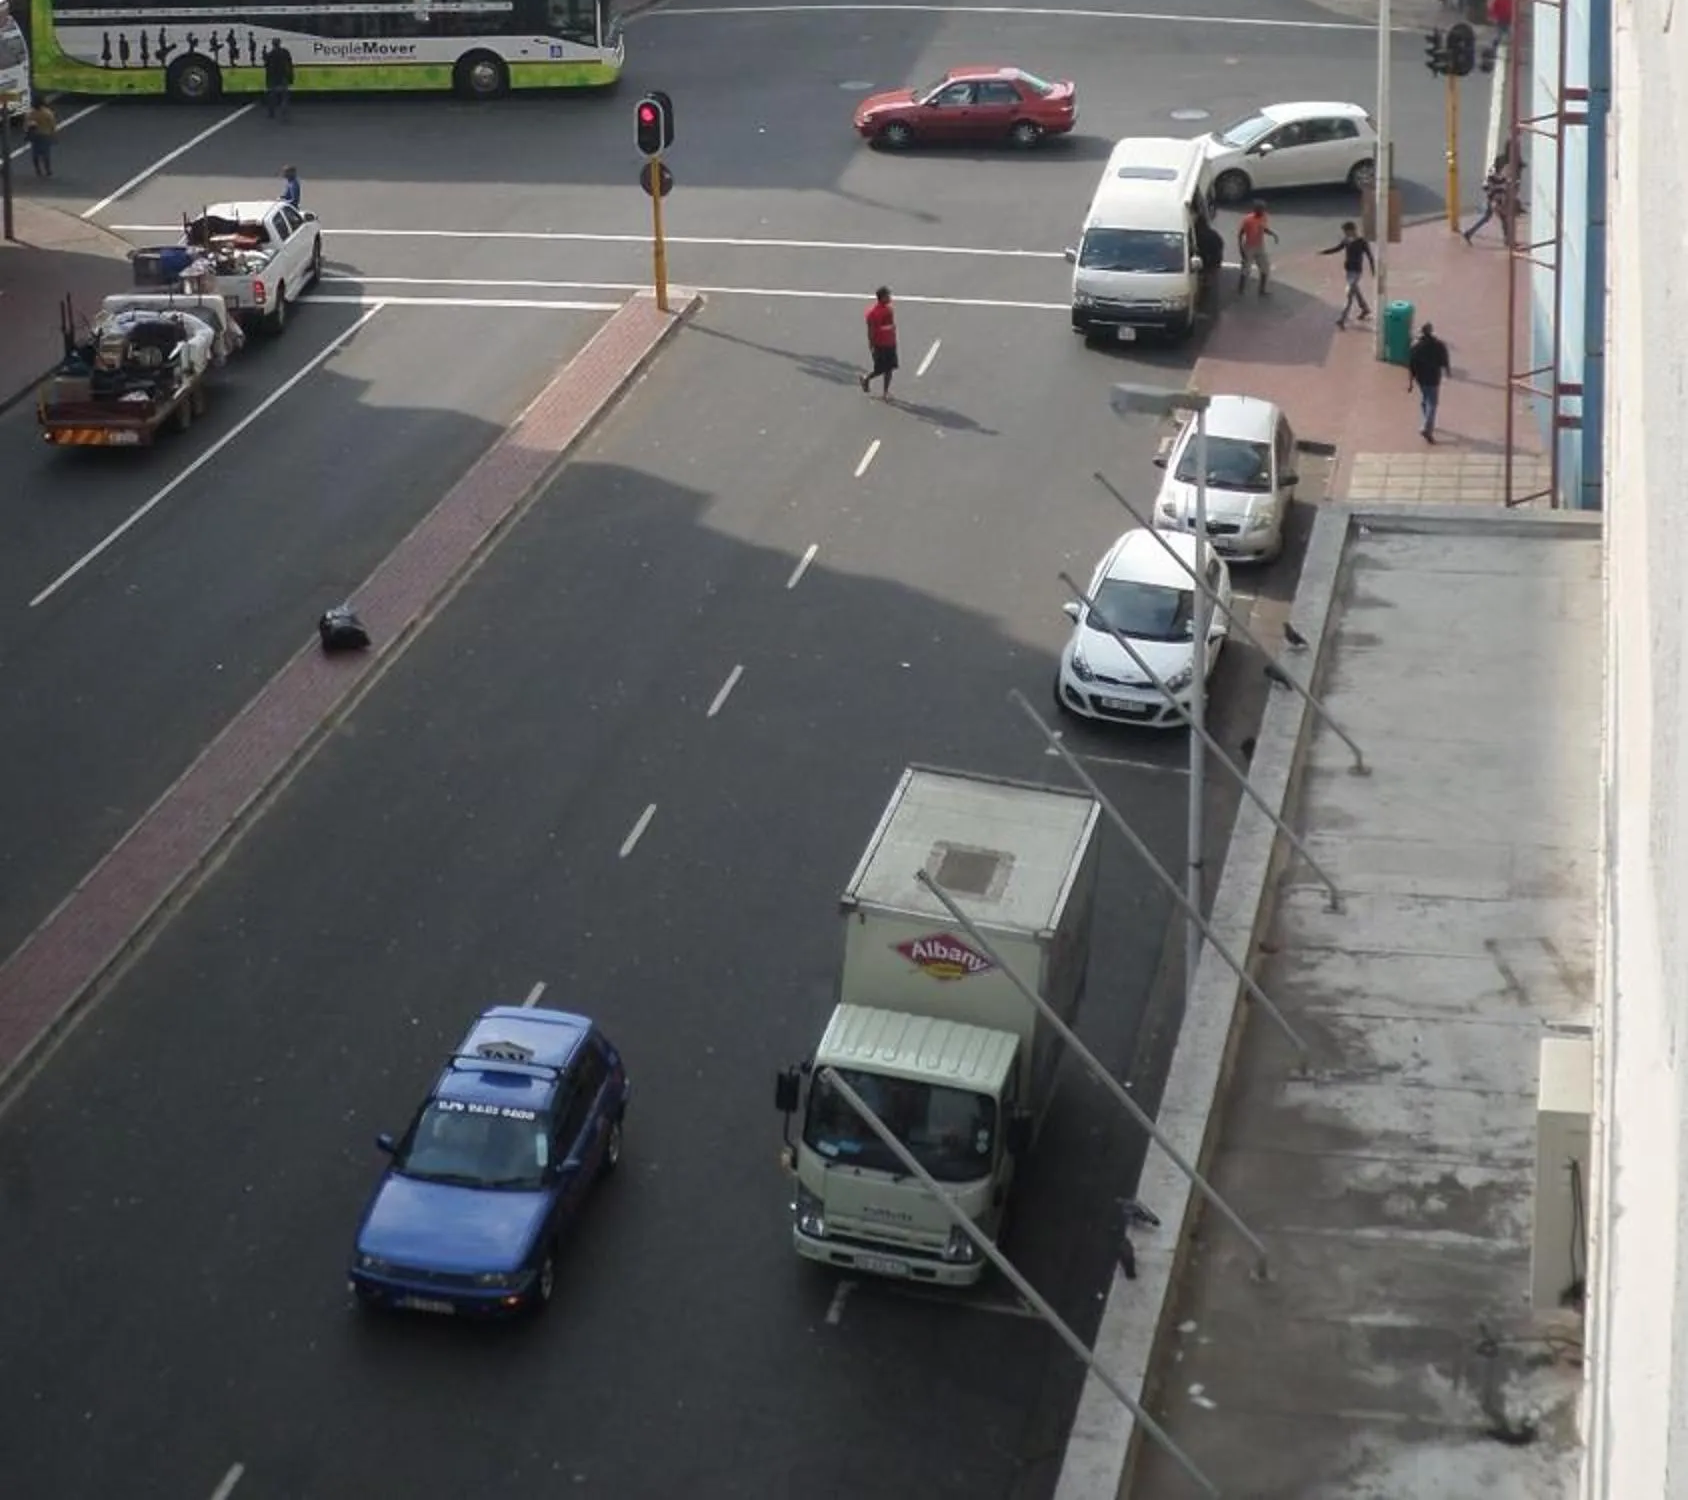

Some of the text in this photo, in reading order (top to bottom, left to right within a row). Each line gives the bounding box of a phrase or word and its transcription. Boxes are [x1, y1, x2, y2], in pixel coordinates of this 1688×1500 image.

[312, 41, 417, 58] PeopleMover
[911, 938, 989, 973] Albany
[483, 1049, 525, 1061] TAXI
